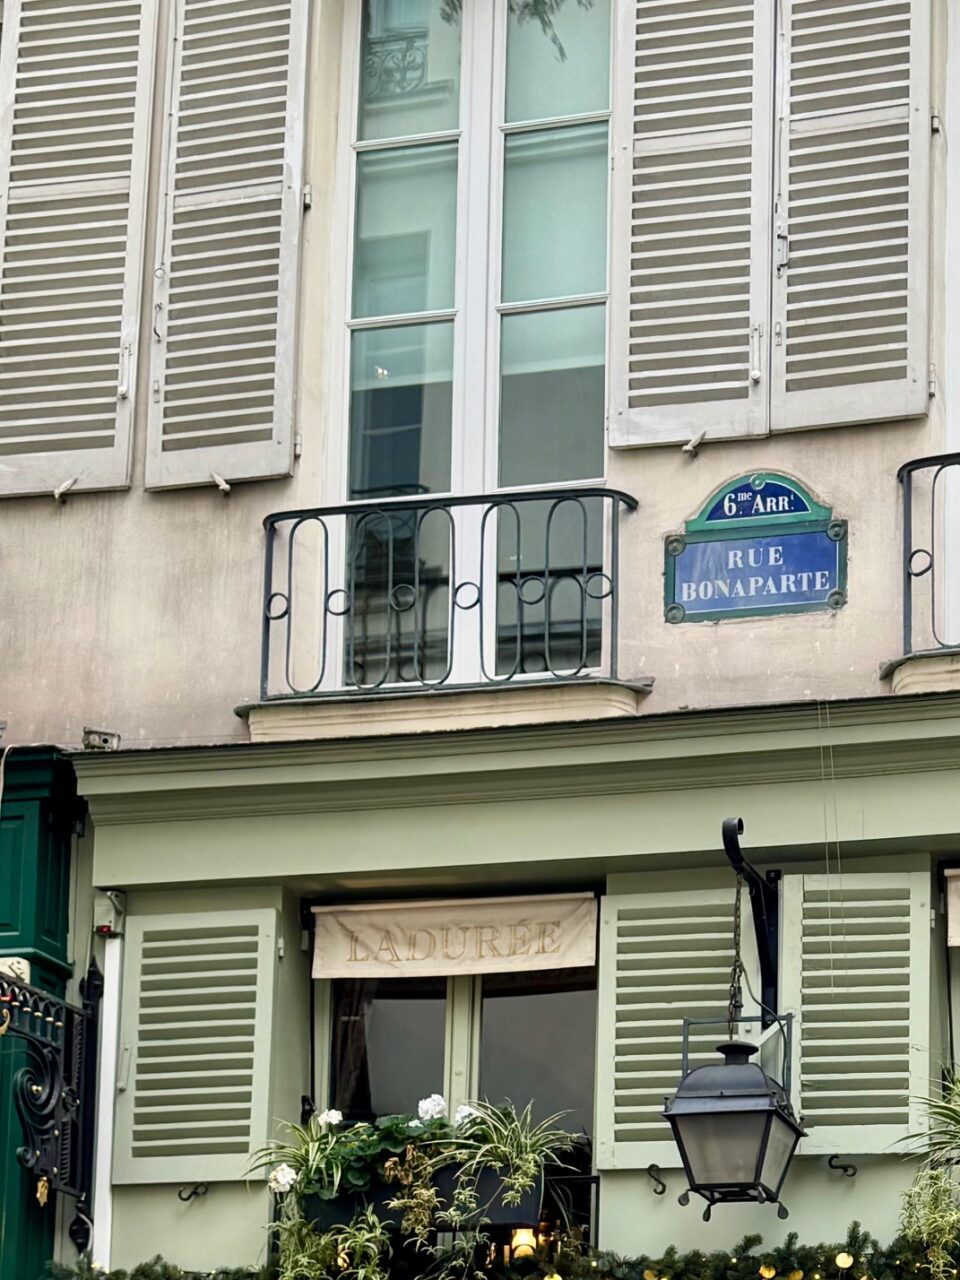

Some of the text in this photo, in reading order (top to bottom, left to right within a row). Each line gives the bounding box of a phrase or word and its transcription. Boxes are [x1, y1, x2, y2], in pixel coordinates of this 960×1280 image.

[727, 546, 784, 570] RUE
[681, 571, 830, 601] BONAPARTE
[346, 919, 562, 963] LADURÉE
